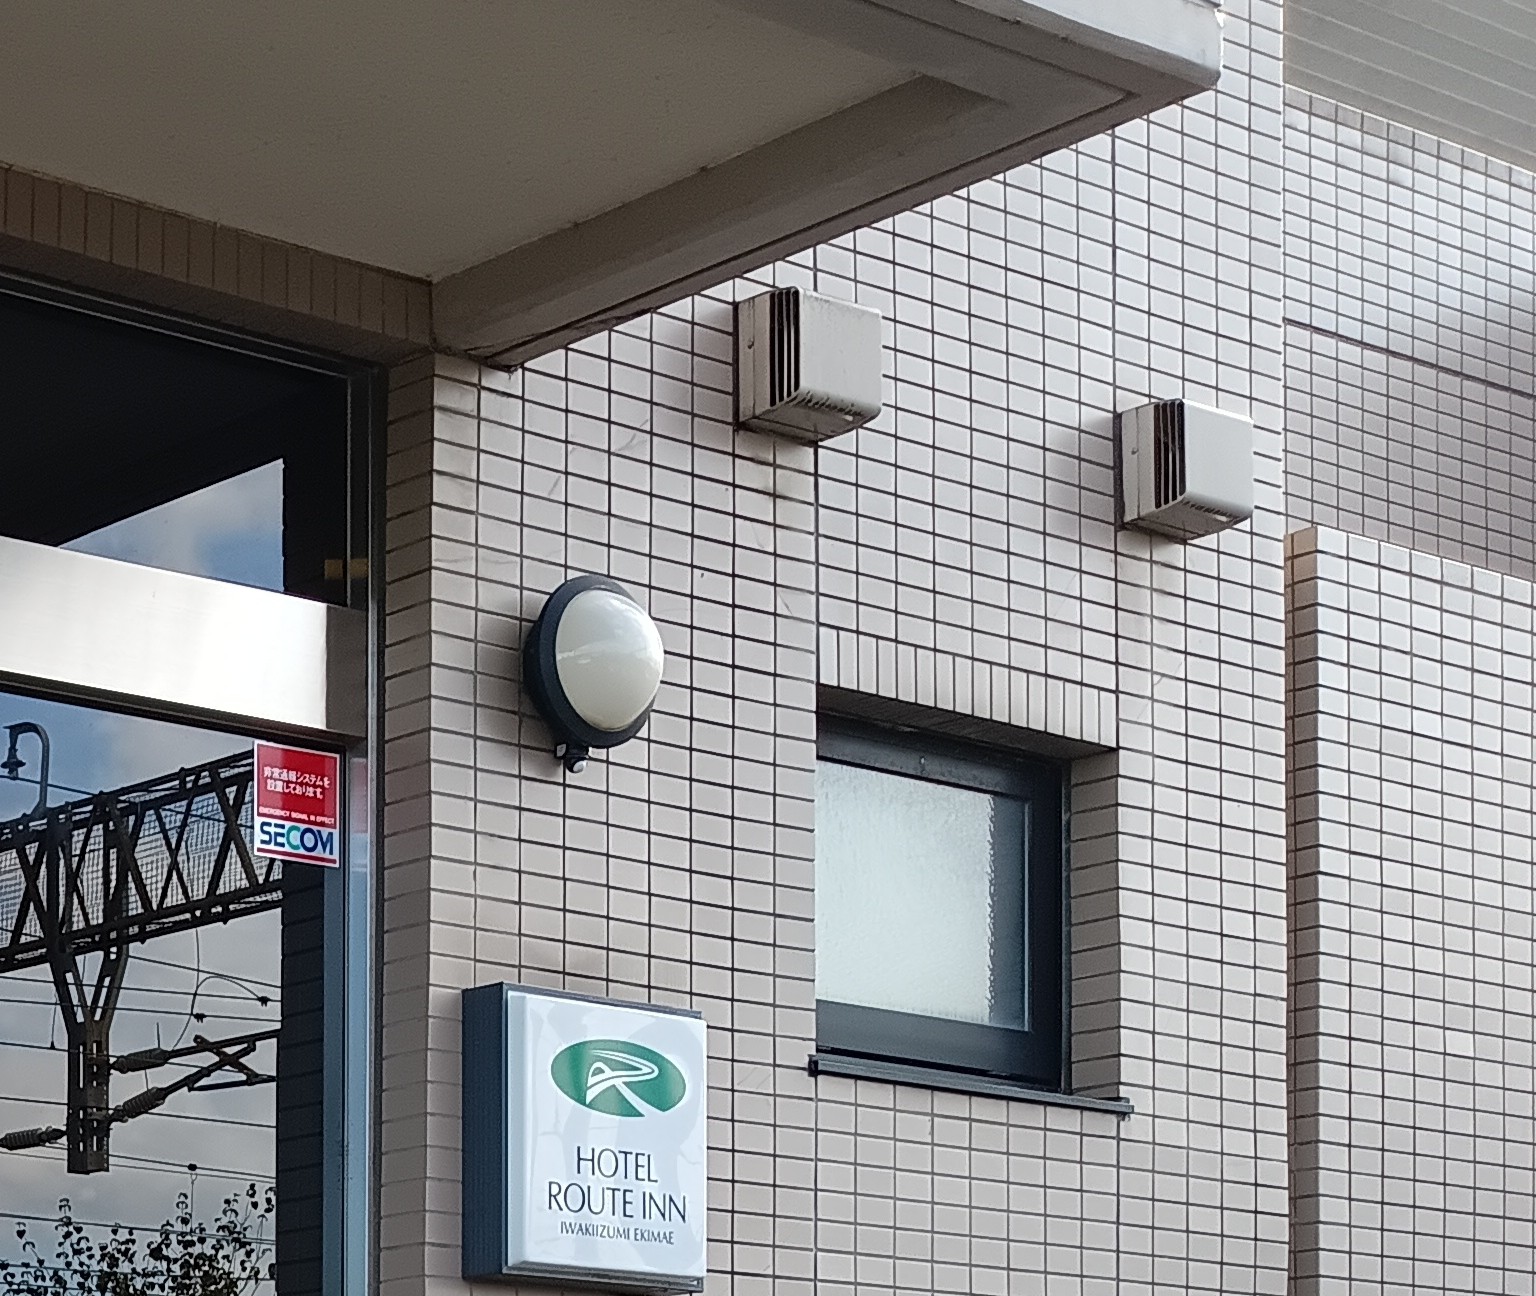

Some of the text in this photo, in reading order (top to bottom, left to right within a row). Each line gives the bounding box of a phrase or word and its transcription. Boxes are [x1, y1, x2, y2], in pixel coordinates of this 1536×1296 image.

[260, 821, 333, 855] SECOM
[576, 1146, 658, 1183] HOTEL
[548, 1181, 687, 1223] ROUTE INN
[560, 1221, 675, 1245] IWAKIIZUMI EKIMAE
